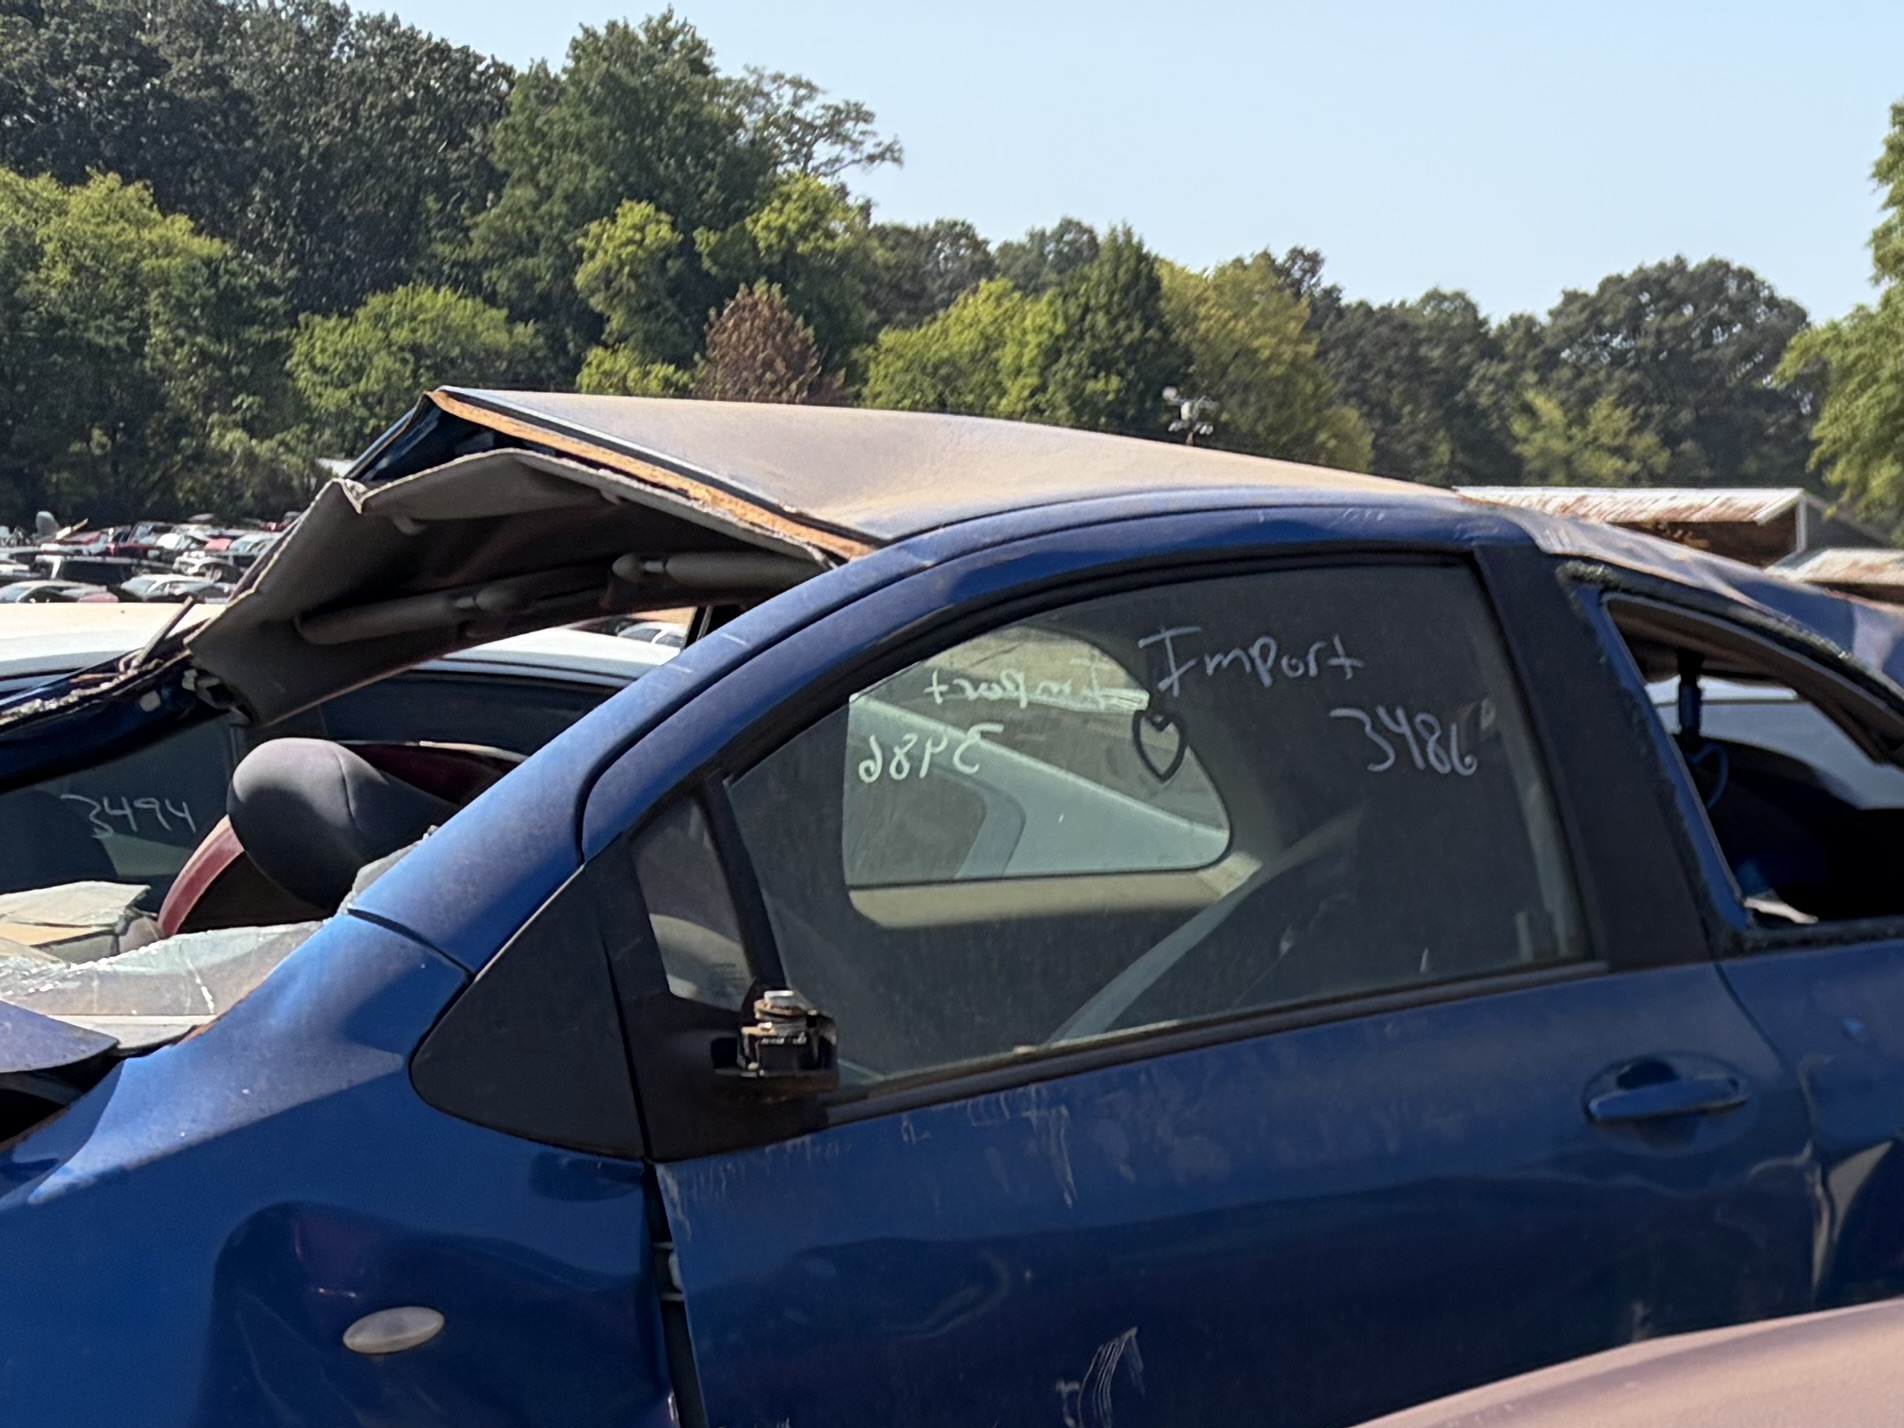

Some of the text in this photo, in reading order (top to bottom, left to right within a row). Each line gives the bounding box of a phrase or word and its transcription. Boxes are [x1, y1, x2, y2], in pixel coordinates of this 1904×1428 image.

[1137, 626, 1365, 698] Import
[1328, 704, 1478, 776] 3486
[60, 793, 197, 839] 3494
